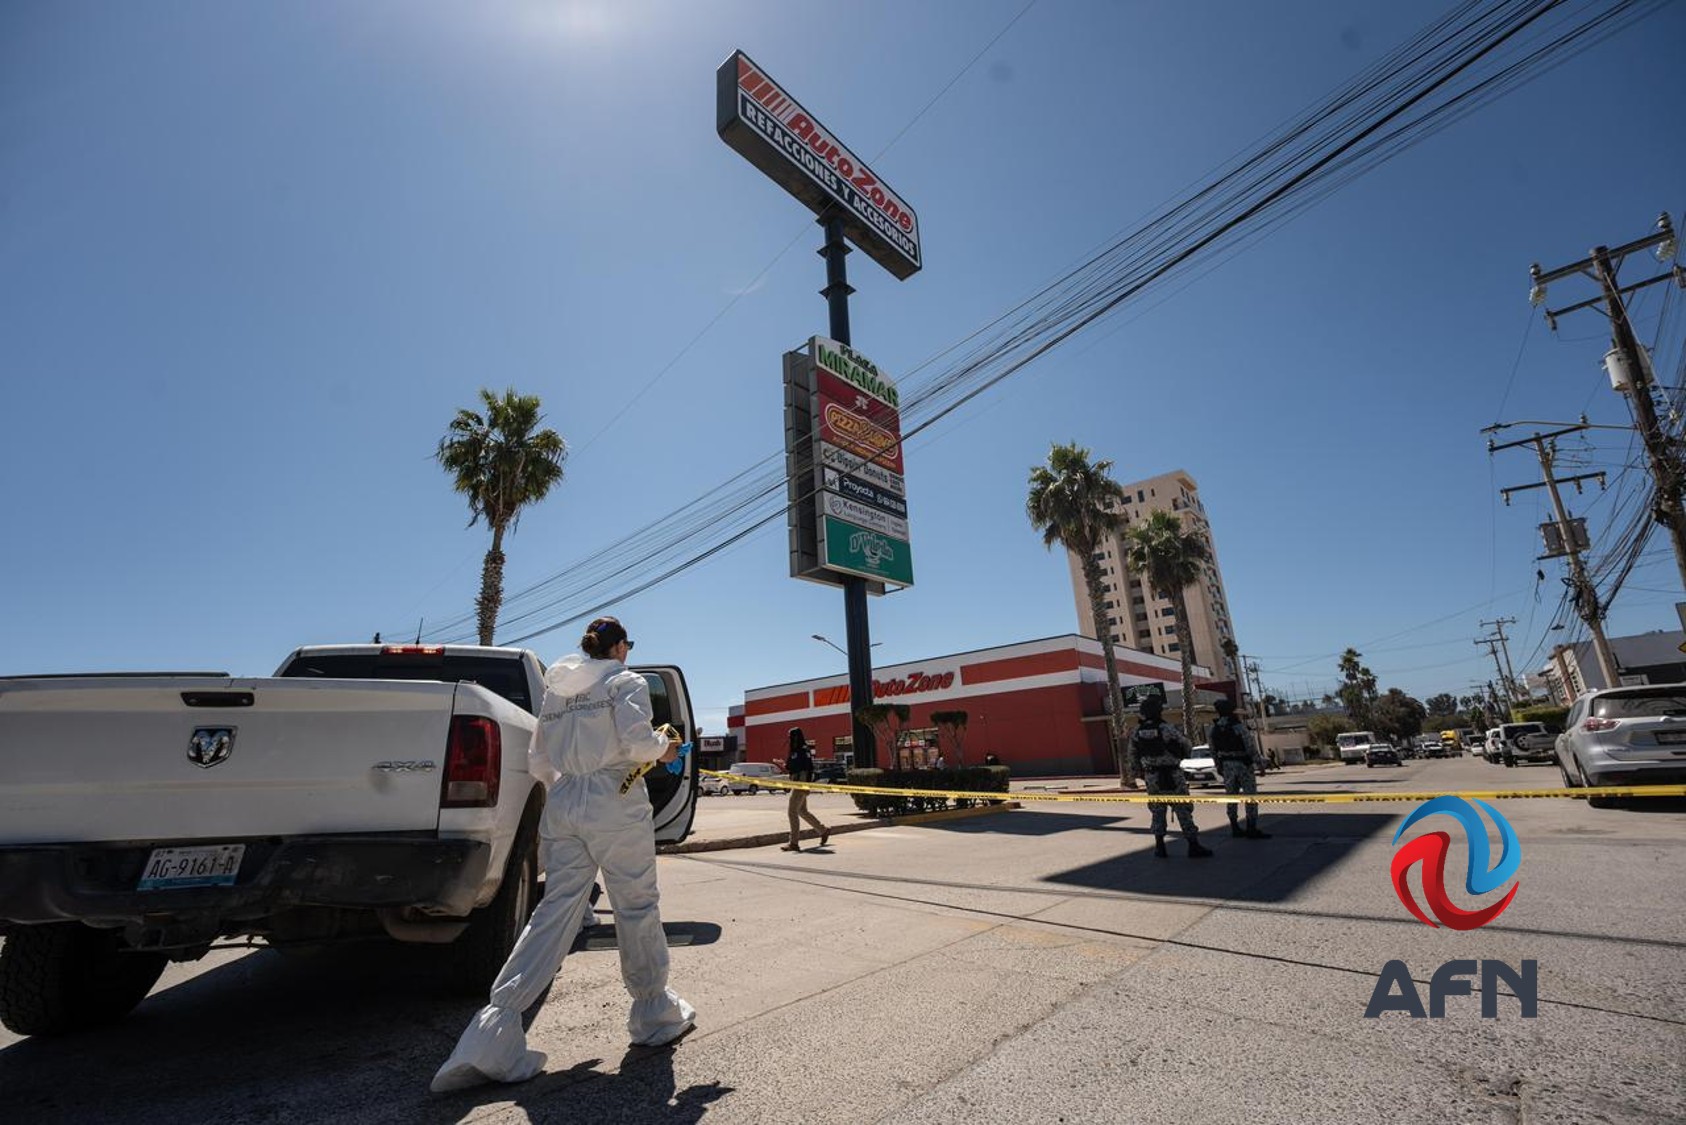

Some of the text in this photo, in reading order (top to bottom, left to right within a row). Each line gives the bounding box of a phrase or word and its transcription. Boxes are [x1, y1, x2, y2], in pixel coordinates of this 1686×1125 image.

[746, 101, 915, 255] REFACCIONES Y ACCESORIOS
[786, 112, 914, 233] AutoZone
[818, 344, 899, 407] MIRAMAR
[840, 344, 878, 376] PLAZA
[843, 498, 886, 522] Kensington
[148, 855, 235, 878] AG-9161-A
